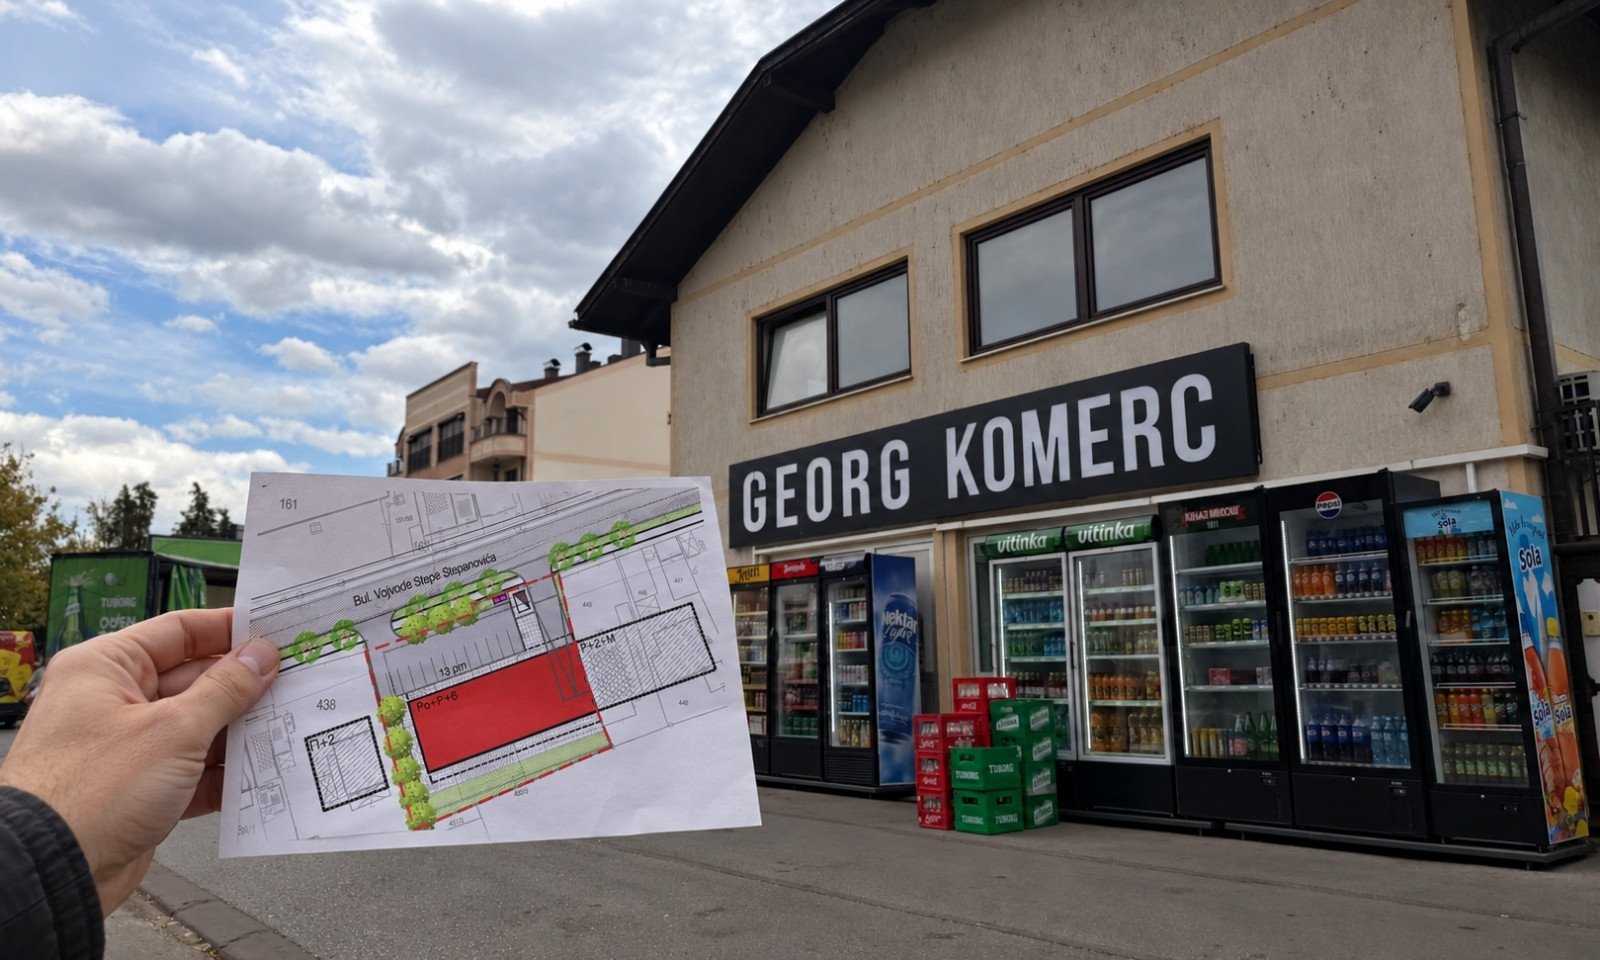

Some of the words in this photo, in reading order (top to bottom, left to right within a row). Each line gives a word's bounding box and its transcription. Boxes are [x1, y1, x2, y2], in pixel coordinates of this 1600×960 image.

[743, 439, 910, 533] GEORG
[945, 373, 1217, 499] KOMERC
[280, 498, 298, 510] 161
[1078, 521, 1135, 545] vitinka
[997, 532, 1048, 554] vitinka
[373, 580, 412, 600] Vojvode
[101, 596, 137, 608] TUBORG
[882, 609, 918, 634] Nektar
[439, 666, 451, 677] 13
[452, 662, 467, 675] pm
[316, 699, 337, 711] 438
[955, 770, 979, 780] TUBORG
[988, 763, 1014, 774] TUBORG
[995, 813, 1018, 824] TUBORG
